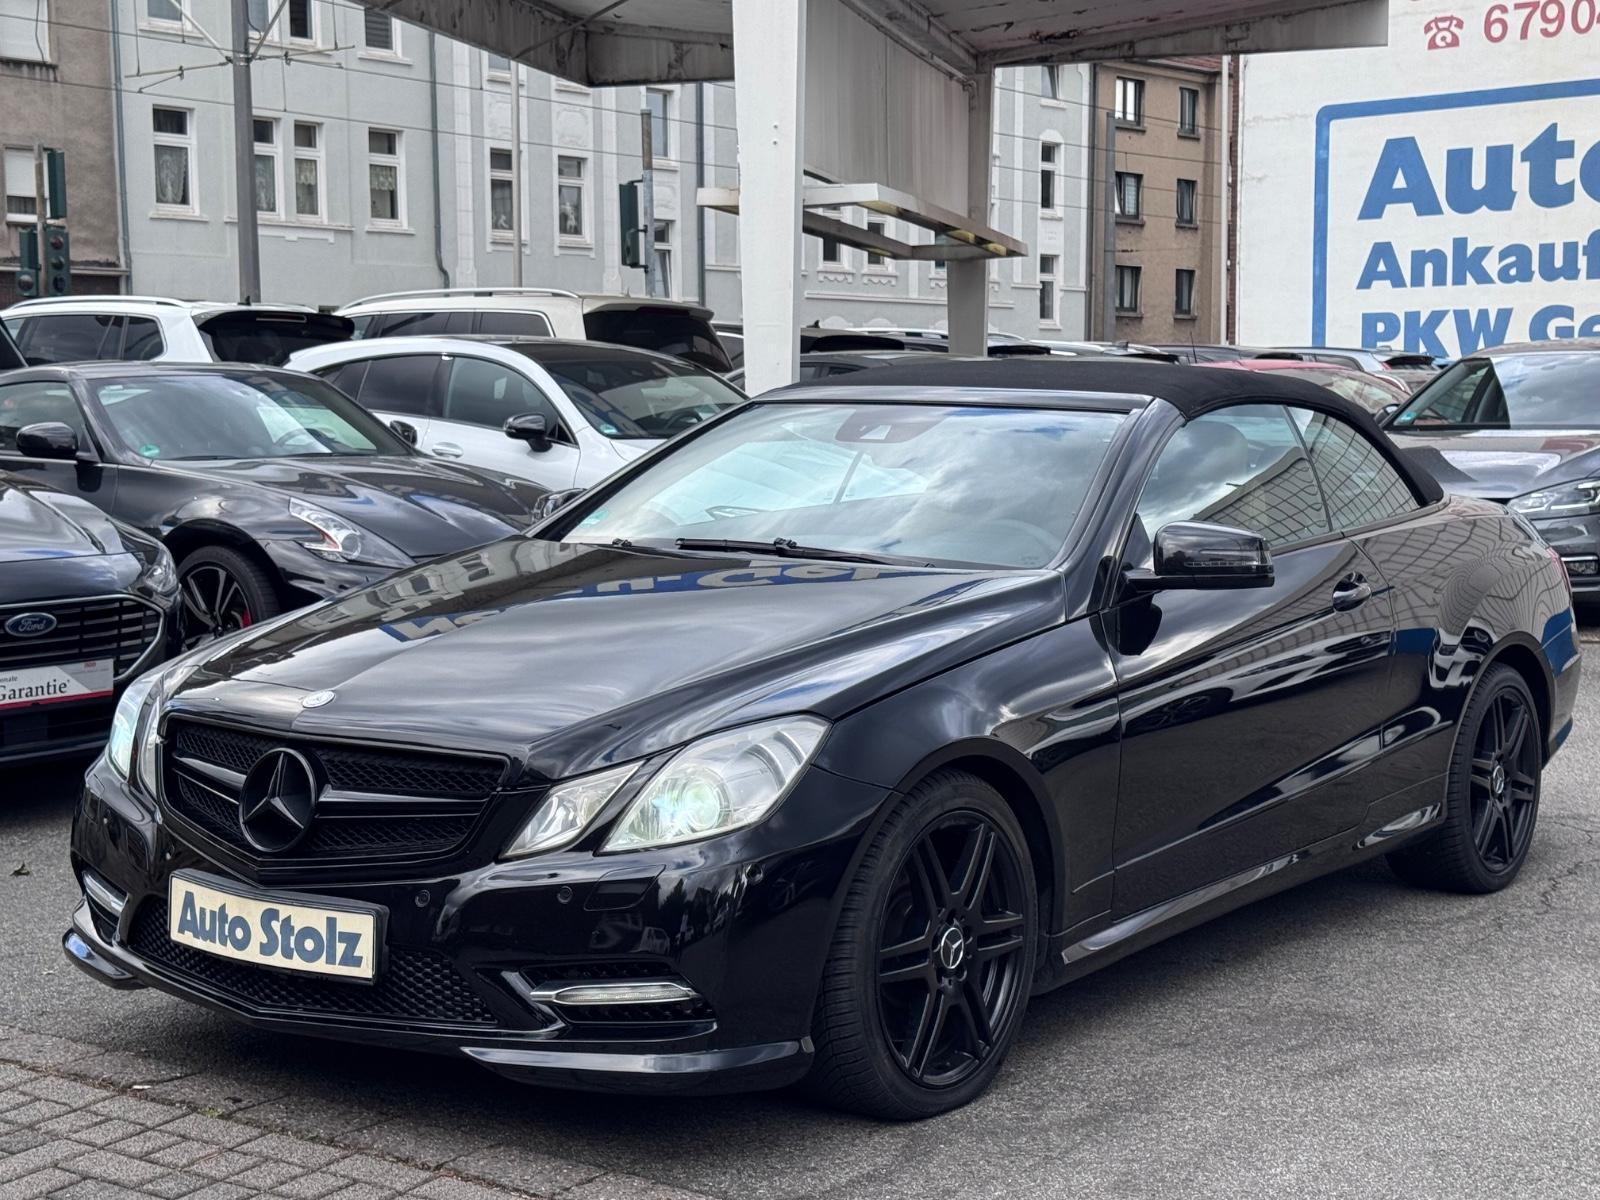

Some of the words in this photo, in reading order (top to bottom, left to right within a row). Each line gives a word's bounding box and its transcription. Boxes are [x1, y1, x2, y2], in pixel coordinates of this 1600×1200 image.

[1484, 0, 1600, 43] 6790
[1361, 307, 1514, 357] PKW
[19, 617, 46, 632] Ford
[177, 890, 252, 952] Auto
[259, 907, 364, 968] Stolz
